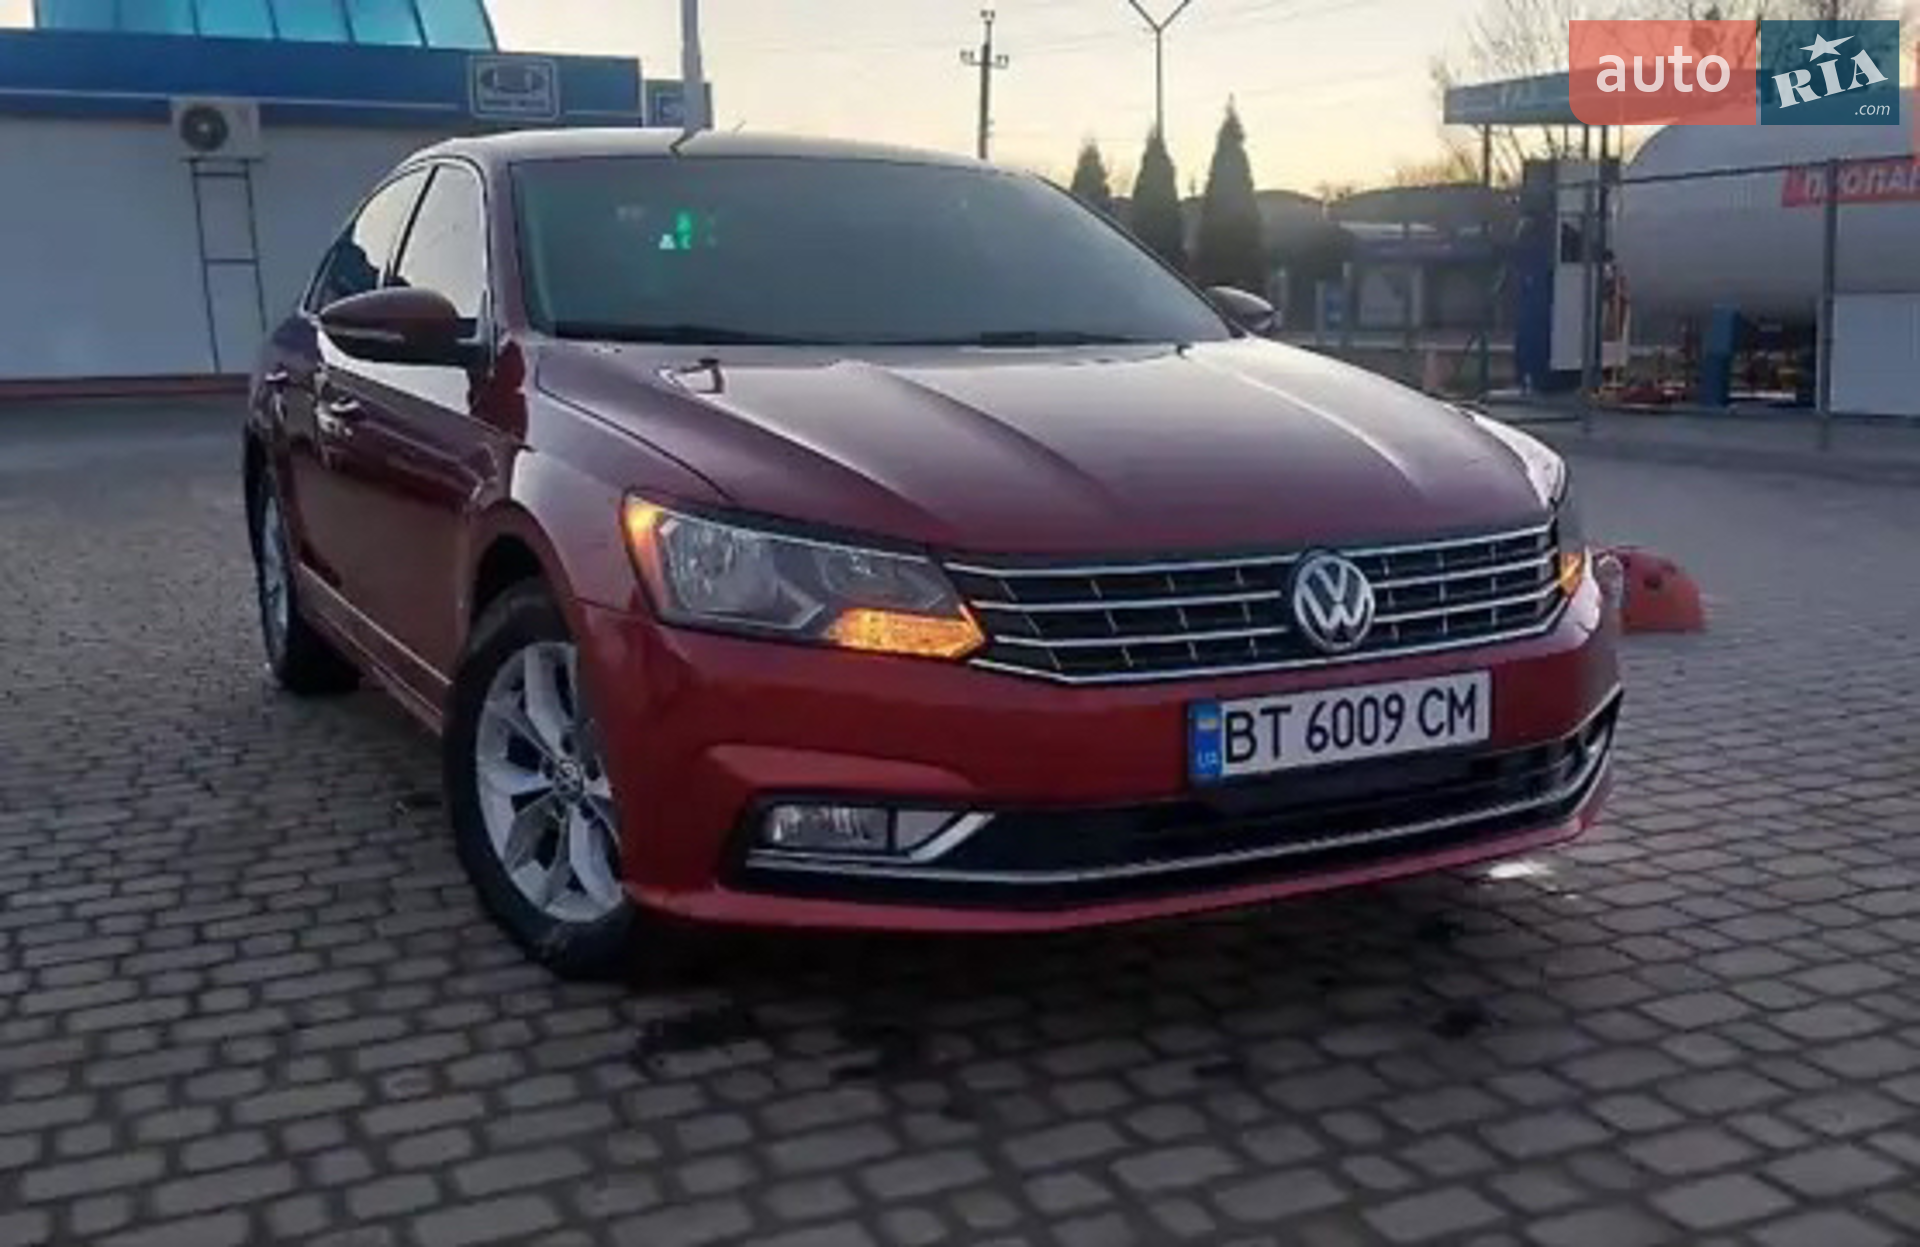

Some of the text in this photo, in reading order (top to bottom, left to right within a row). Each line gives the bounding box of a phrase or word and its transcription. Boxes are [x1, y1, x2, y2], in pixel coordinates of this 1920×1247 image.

[1225, 683, 1477, 764] BT 6009 CM
